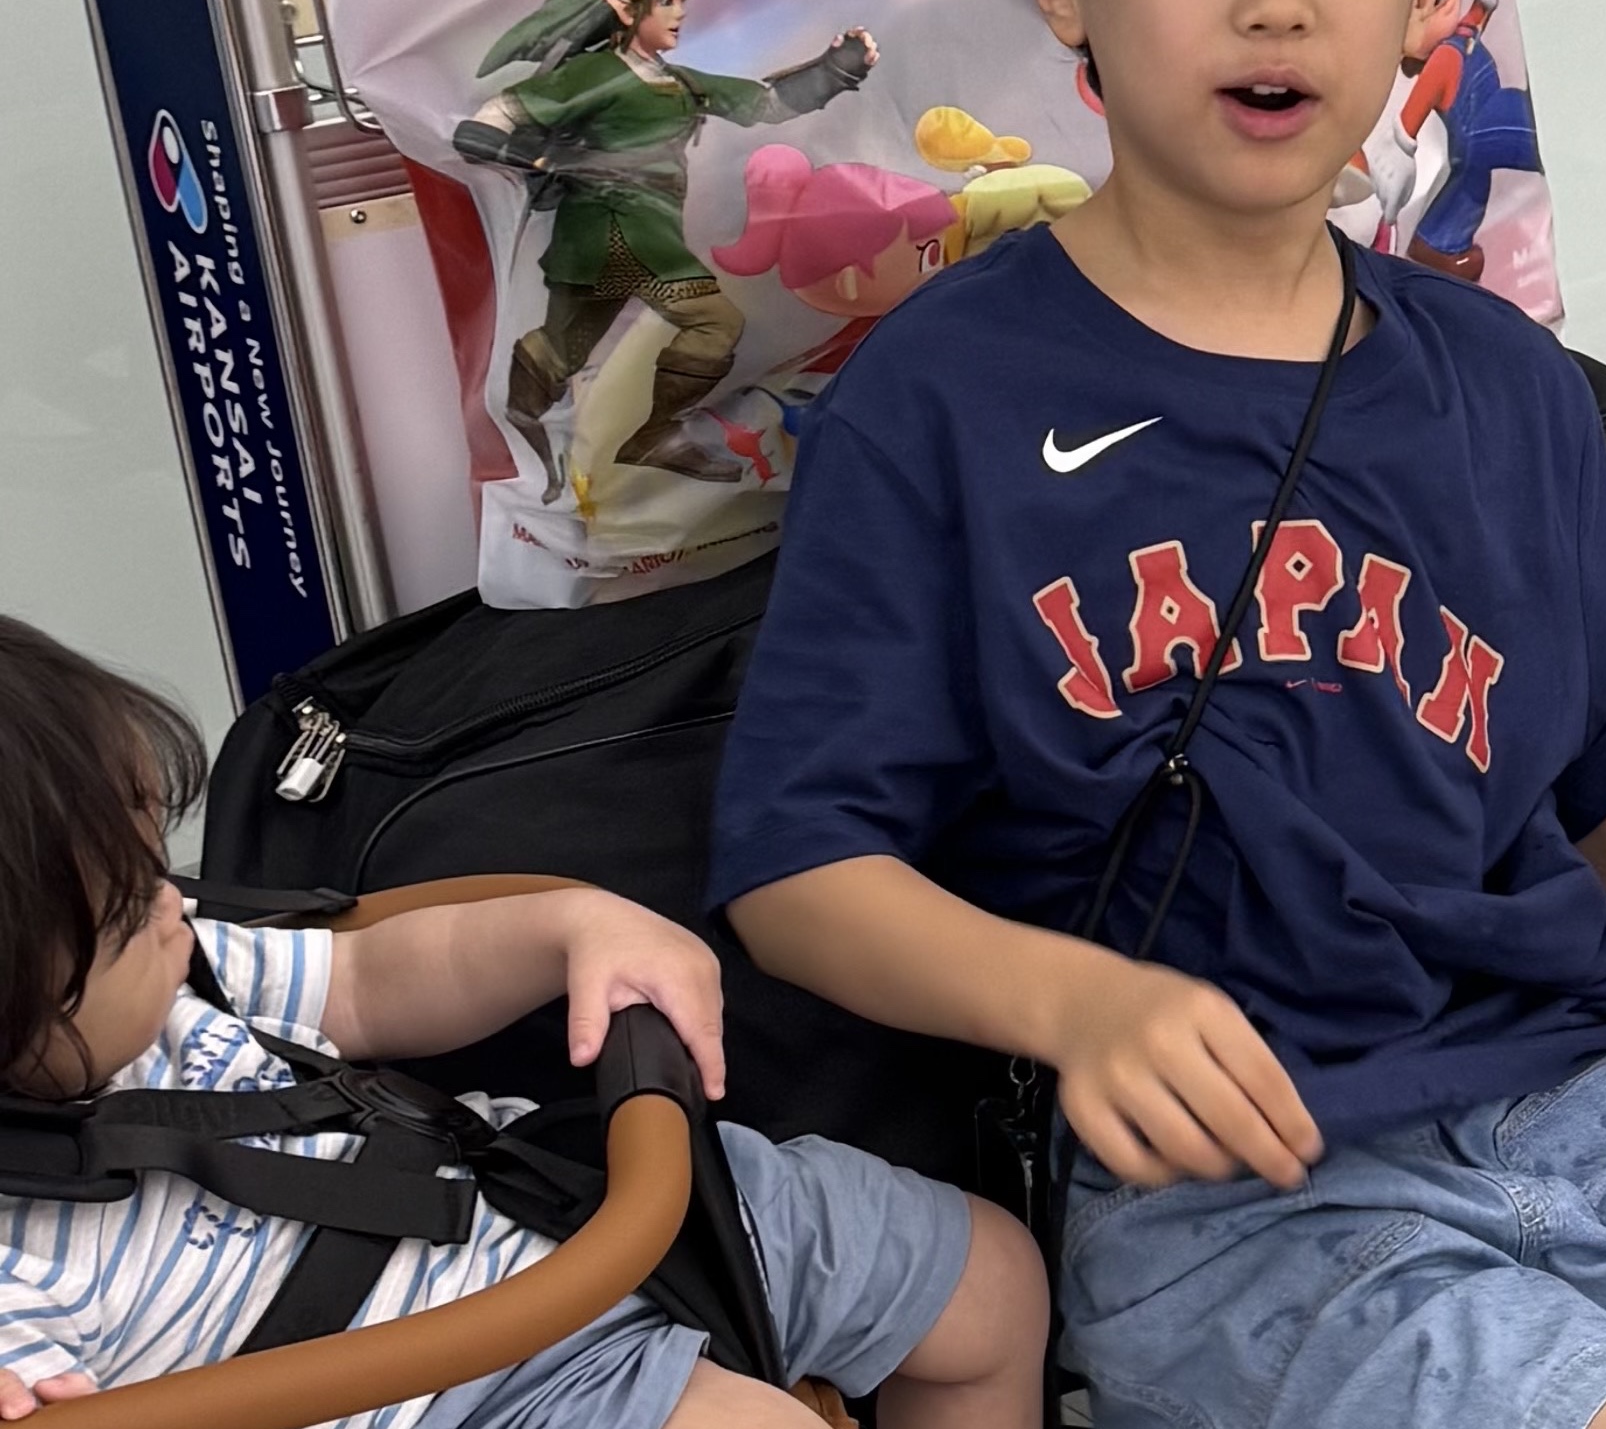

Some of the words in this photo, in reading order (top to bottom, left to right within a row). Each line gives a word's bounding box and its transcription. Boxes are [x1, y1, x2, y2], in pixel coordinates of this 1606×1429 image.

[167, 239, 251, 570] AIRPORTS
[195, 253, 263, 505] KANSAI
[200, 119, 245, 285] Shaping
[238, 299, 252, 322] a
[245, 337, 274, 429] New
[265, 439, 308, 598] Journey
[1032, 518, 1504, 773] JAPAN
